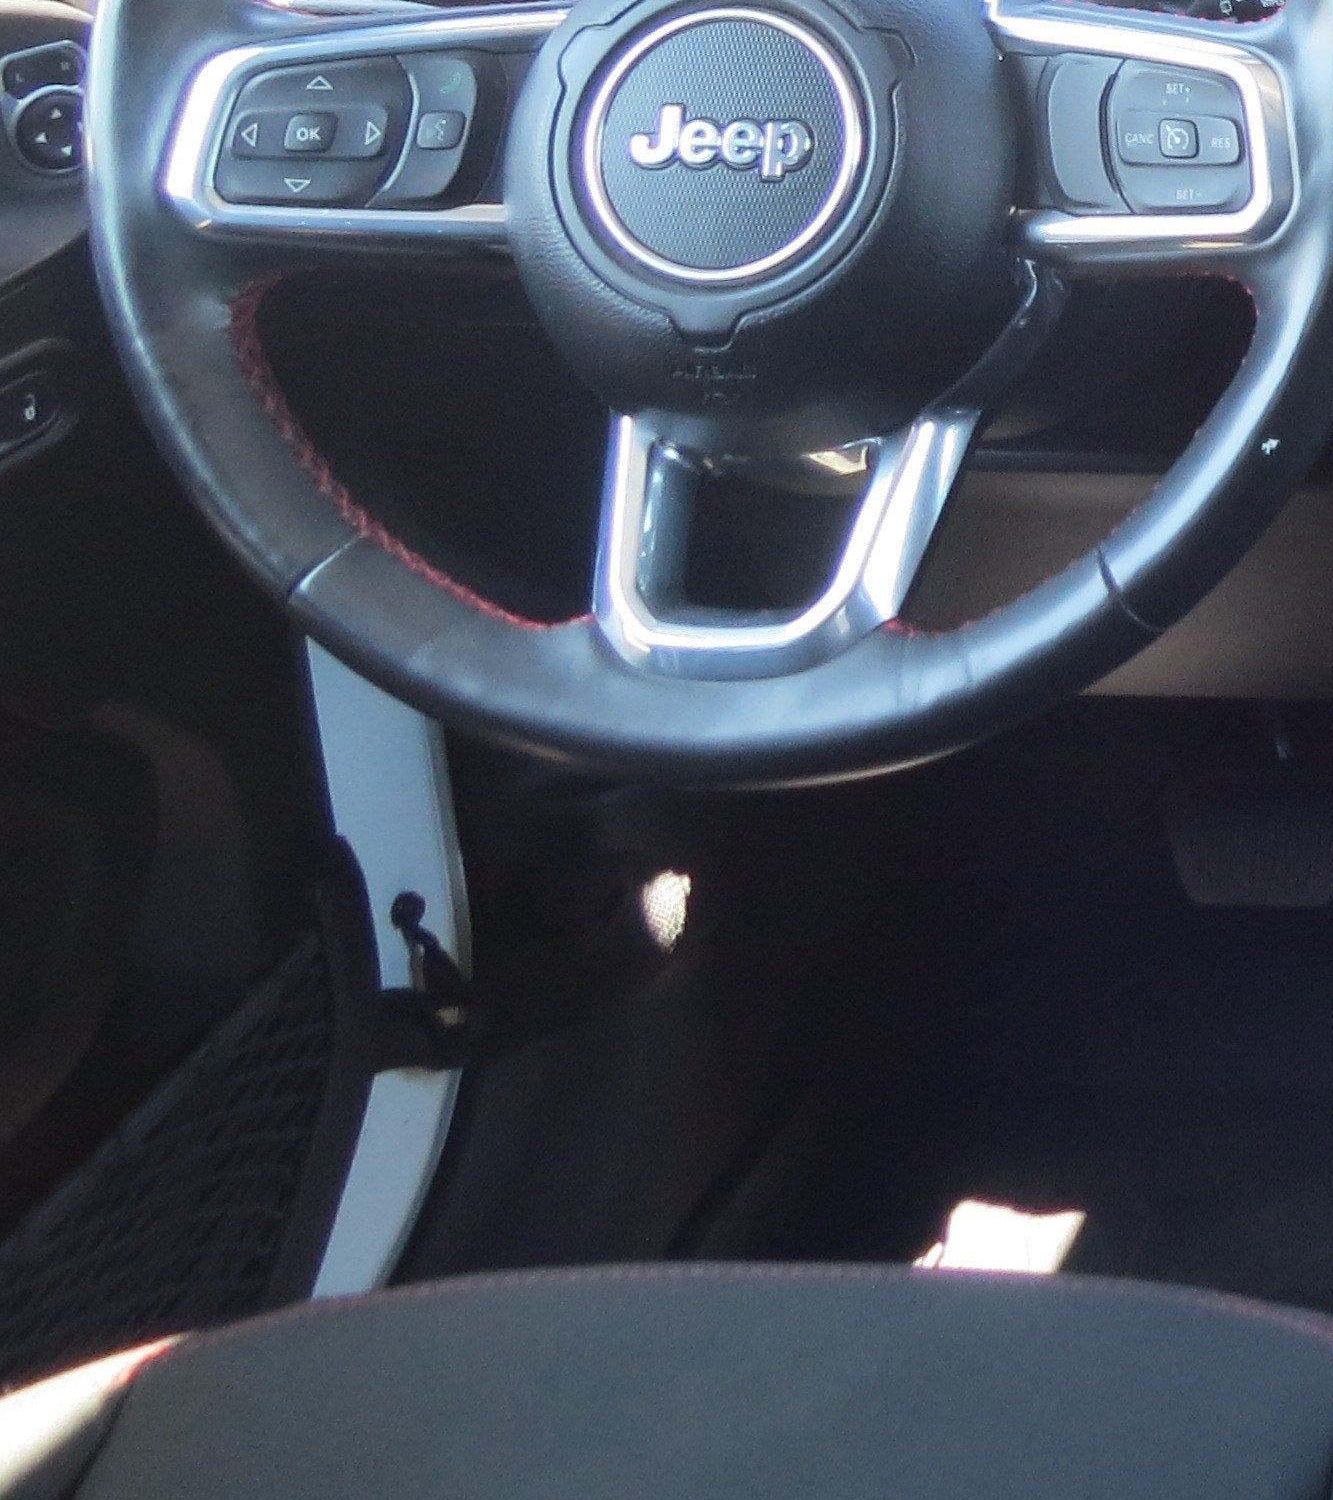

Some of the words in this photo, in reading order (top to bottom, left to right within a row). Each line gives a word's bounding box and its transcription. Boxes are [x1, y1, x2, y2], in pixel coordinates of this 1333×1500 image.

[296, 128, 321, 141] OK
[630, 103, 815, 180] Jeep
[1210, 137, 1231, 148] RES
